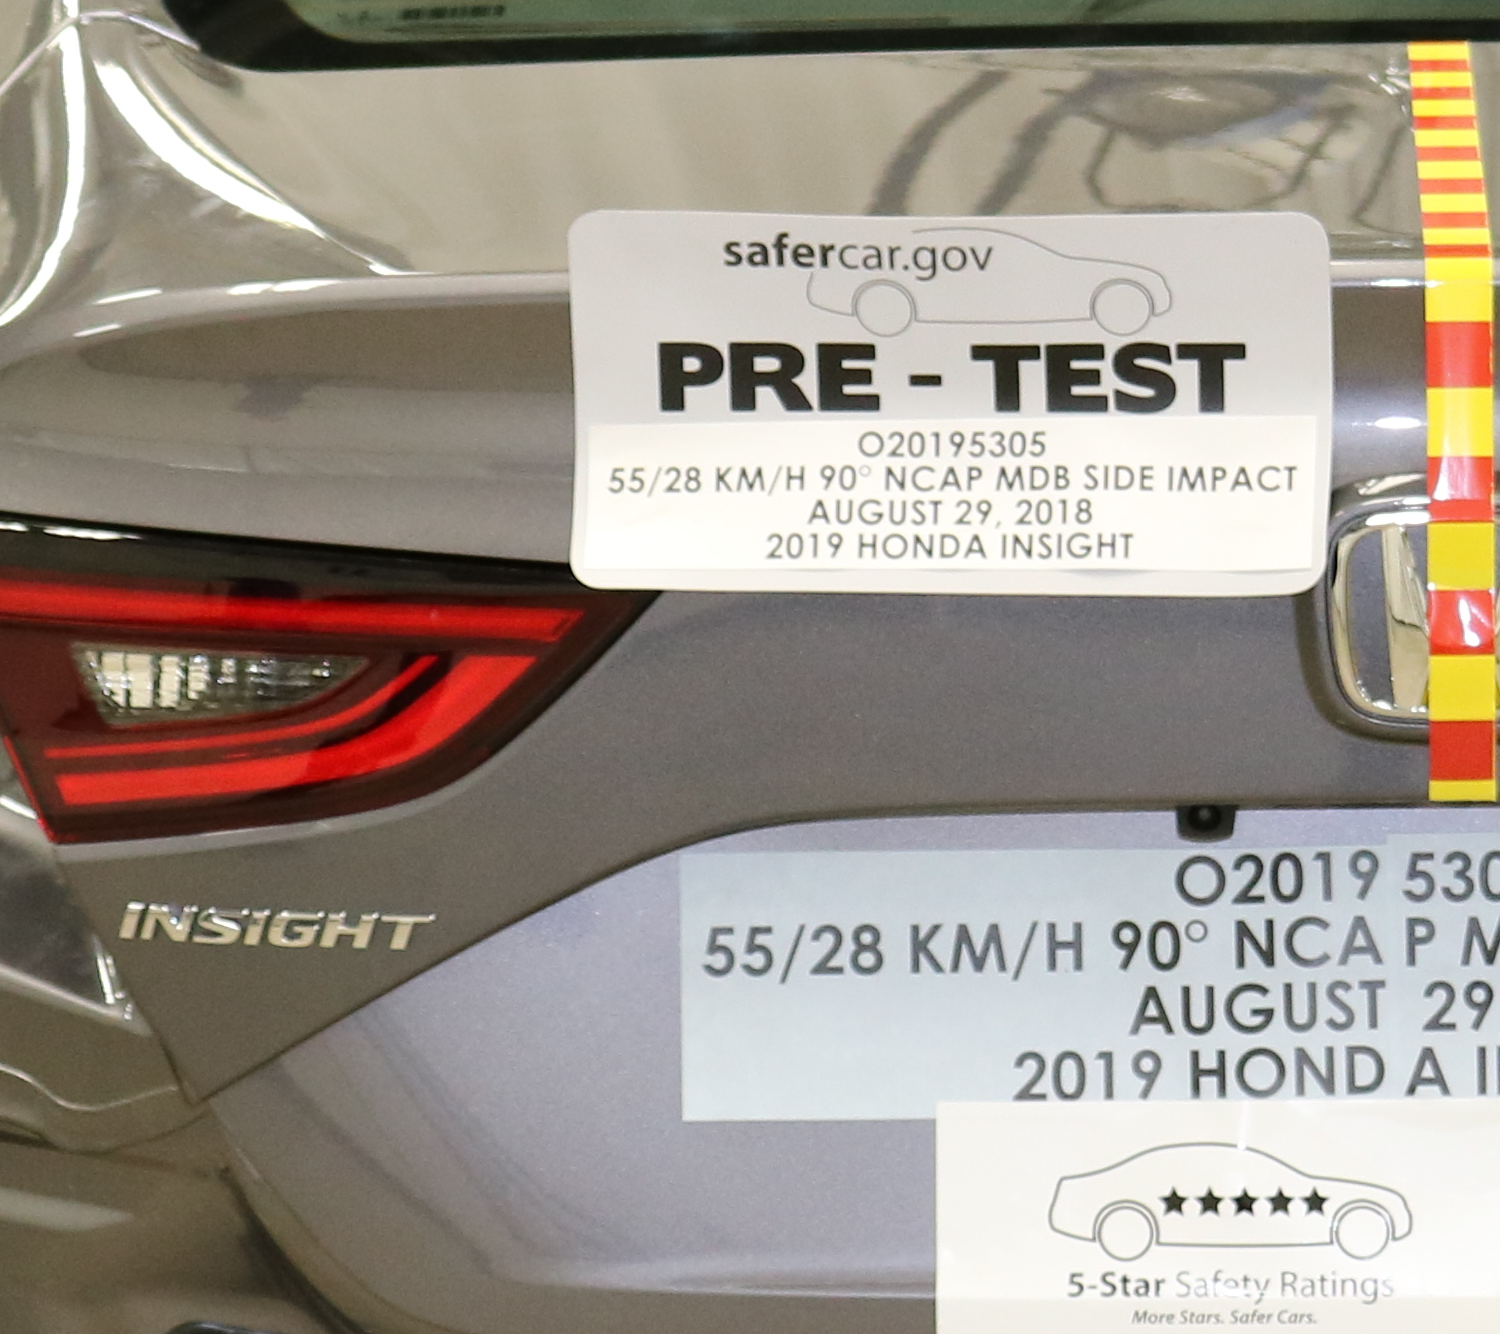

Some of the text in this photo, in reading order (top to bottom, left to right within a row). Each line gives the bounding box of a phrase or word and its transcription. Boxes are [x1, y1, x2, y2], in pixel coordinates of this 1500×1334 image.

[723, 231, 993, 281] safercar.gov
[657, 341, 881, 412] PRE
[970, 341, 1247, 414] TEST
[607, 467, 703, 495] 55/28
[715, 464, 806, 494] KM/H
[884, 464, 984, 492] NCAP
[994, 464, 1072, 492] MDB
[1083, 464, 1155, 492] SIDE
[1167, 464, 1299, 493] IMPACT
[807, 497, 1094, 530] AUGUST 29, 2018
[765, 531, 1135, 561] 2019 HONDA INSIGHT
[118, 900, 437, 951] INSIGHT
[702, 923, 884, 984] 55/28
[910, 920, 1083, 981] KM/H
[1130, 979, 1386, 1036] AUGUST
[1013, 1049, 1163, 1101] 2019
[1067, 1269, 1395, 1305] 5-Star Safety Ratings
[1131, 1308, 1318, 1325] More Stars. Safer Cars.
